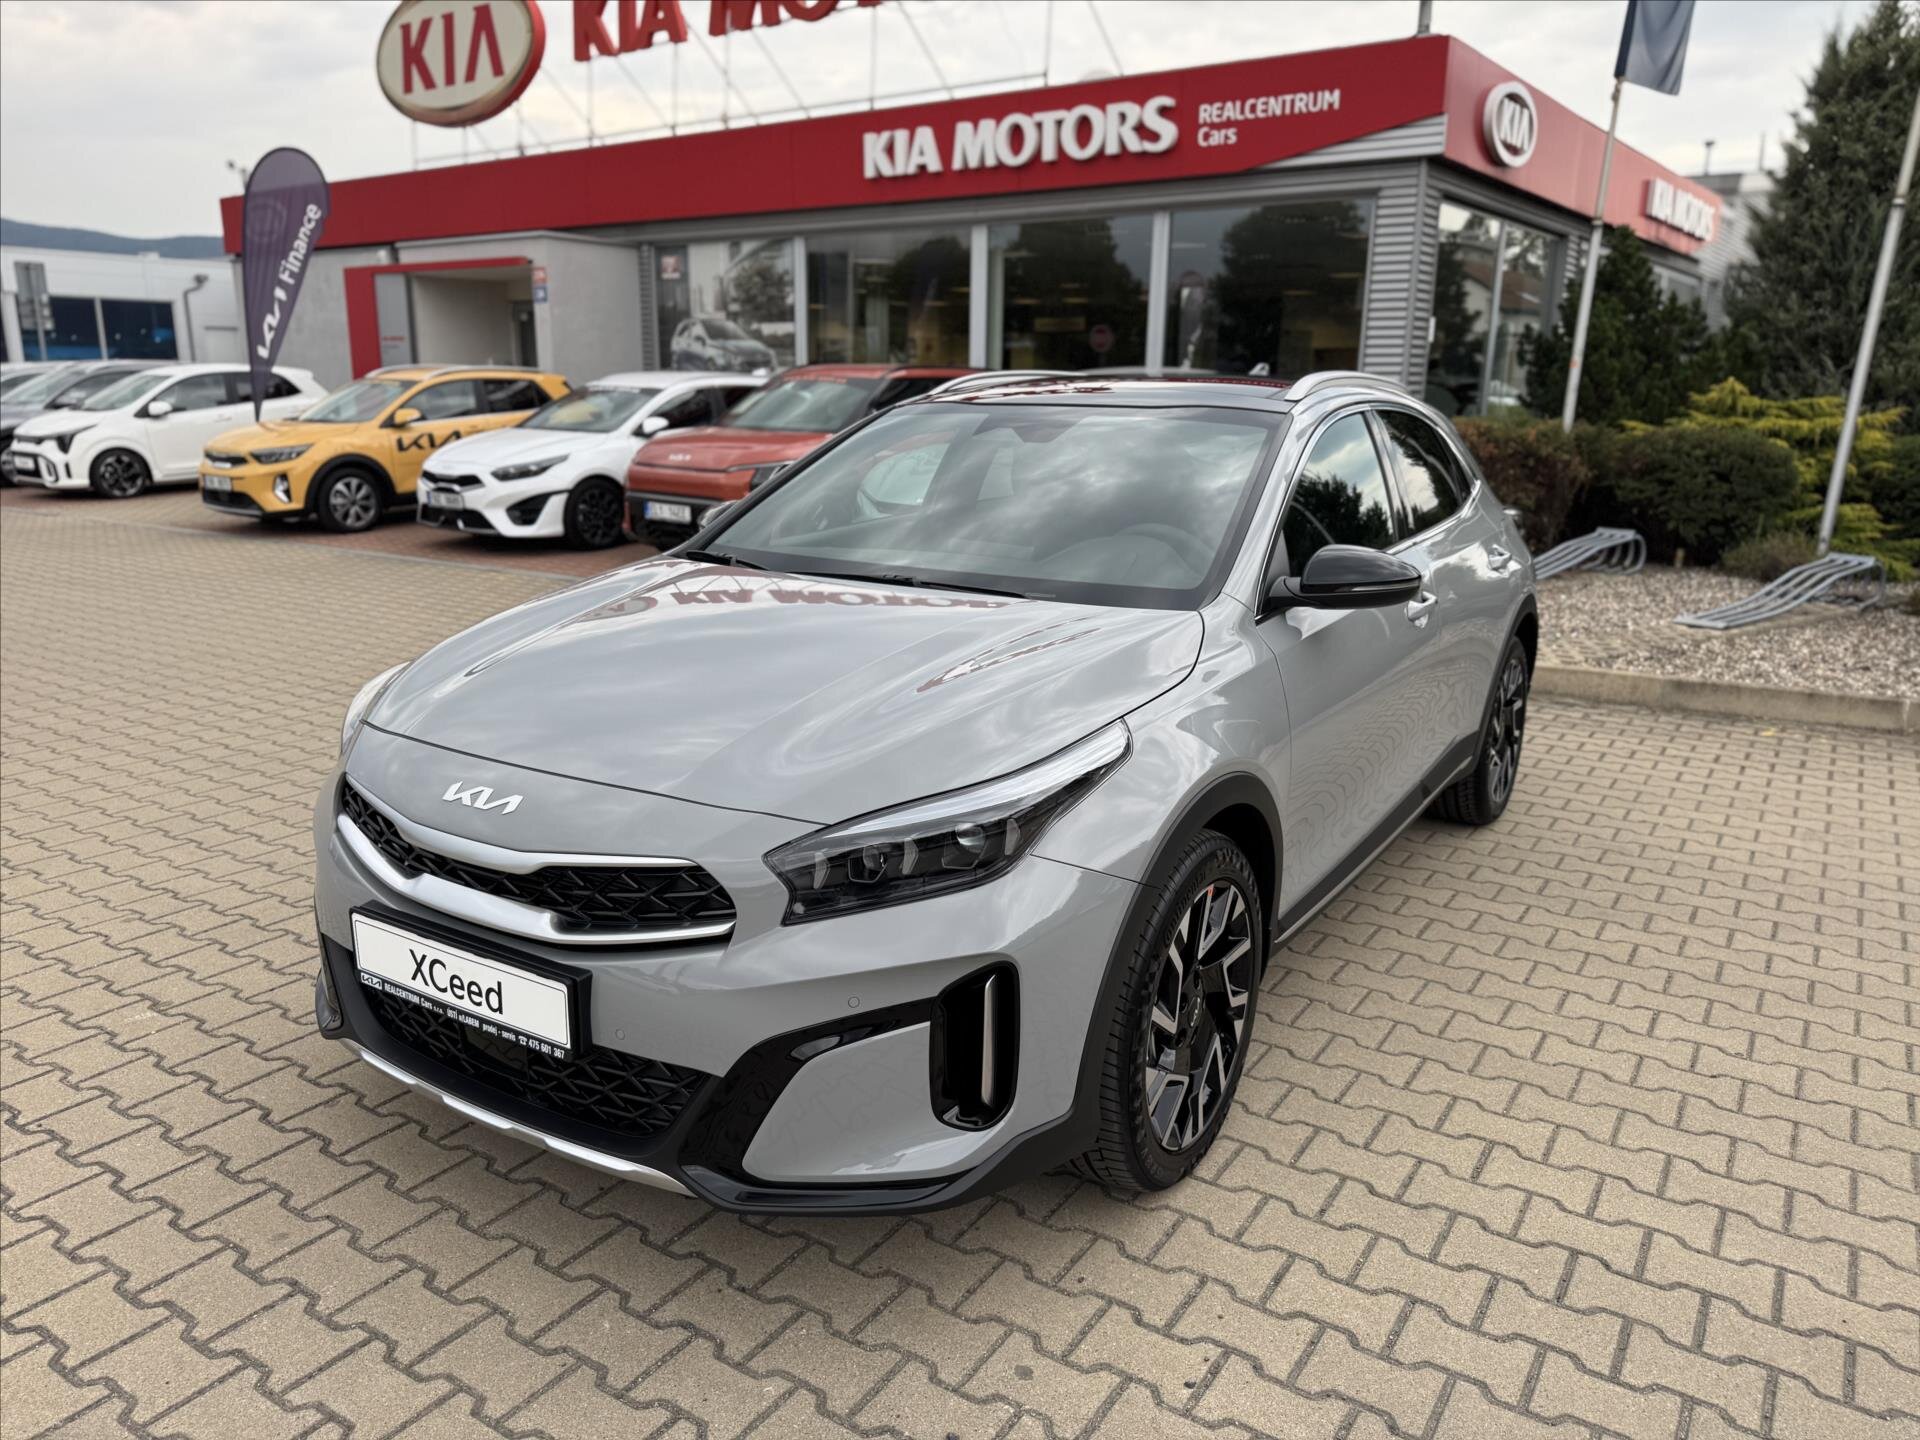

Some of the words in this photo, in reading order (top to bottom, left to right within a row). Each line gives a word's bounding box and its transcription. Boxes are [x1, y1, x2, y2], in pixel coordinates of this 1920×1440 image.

[400, 4, 505, 94] KIA
[862, 126, 942, 179] KIA
[952, 95, 1179, 171] MOTORS
[1198, 89, 1341, 124] REALCENTRUM
[1198, 126, 1237, 148] Cars
[1500, 96, 1531, 152] KIA
[256, 286, 287, 359] KIA
[278, 203, 322, 286] Finance
[442, 781, 524, 815] KIA
[409, 948, 503, 1016] XCeed
[384, 982, 420, 1004] REALCENTRUM
[420, 997, 433, 1010] Cars
[482, 1023, 498, 1036] prodej
[501, 1031, 516, 1042] servis
[528, 1038, 540, 1050] 475
[540, 1043, 552, 1055] 601
[553, 1047, 565, 1060] 367
